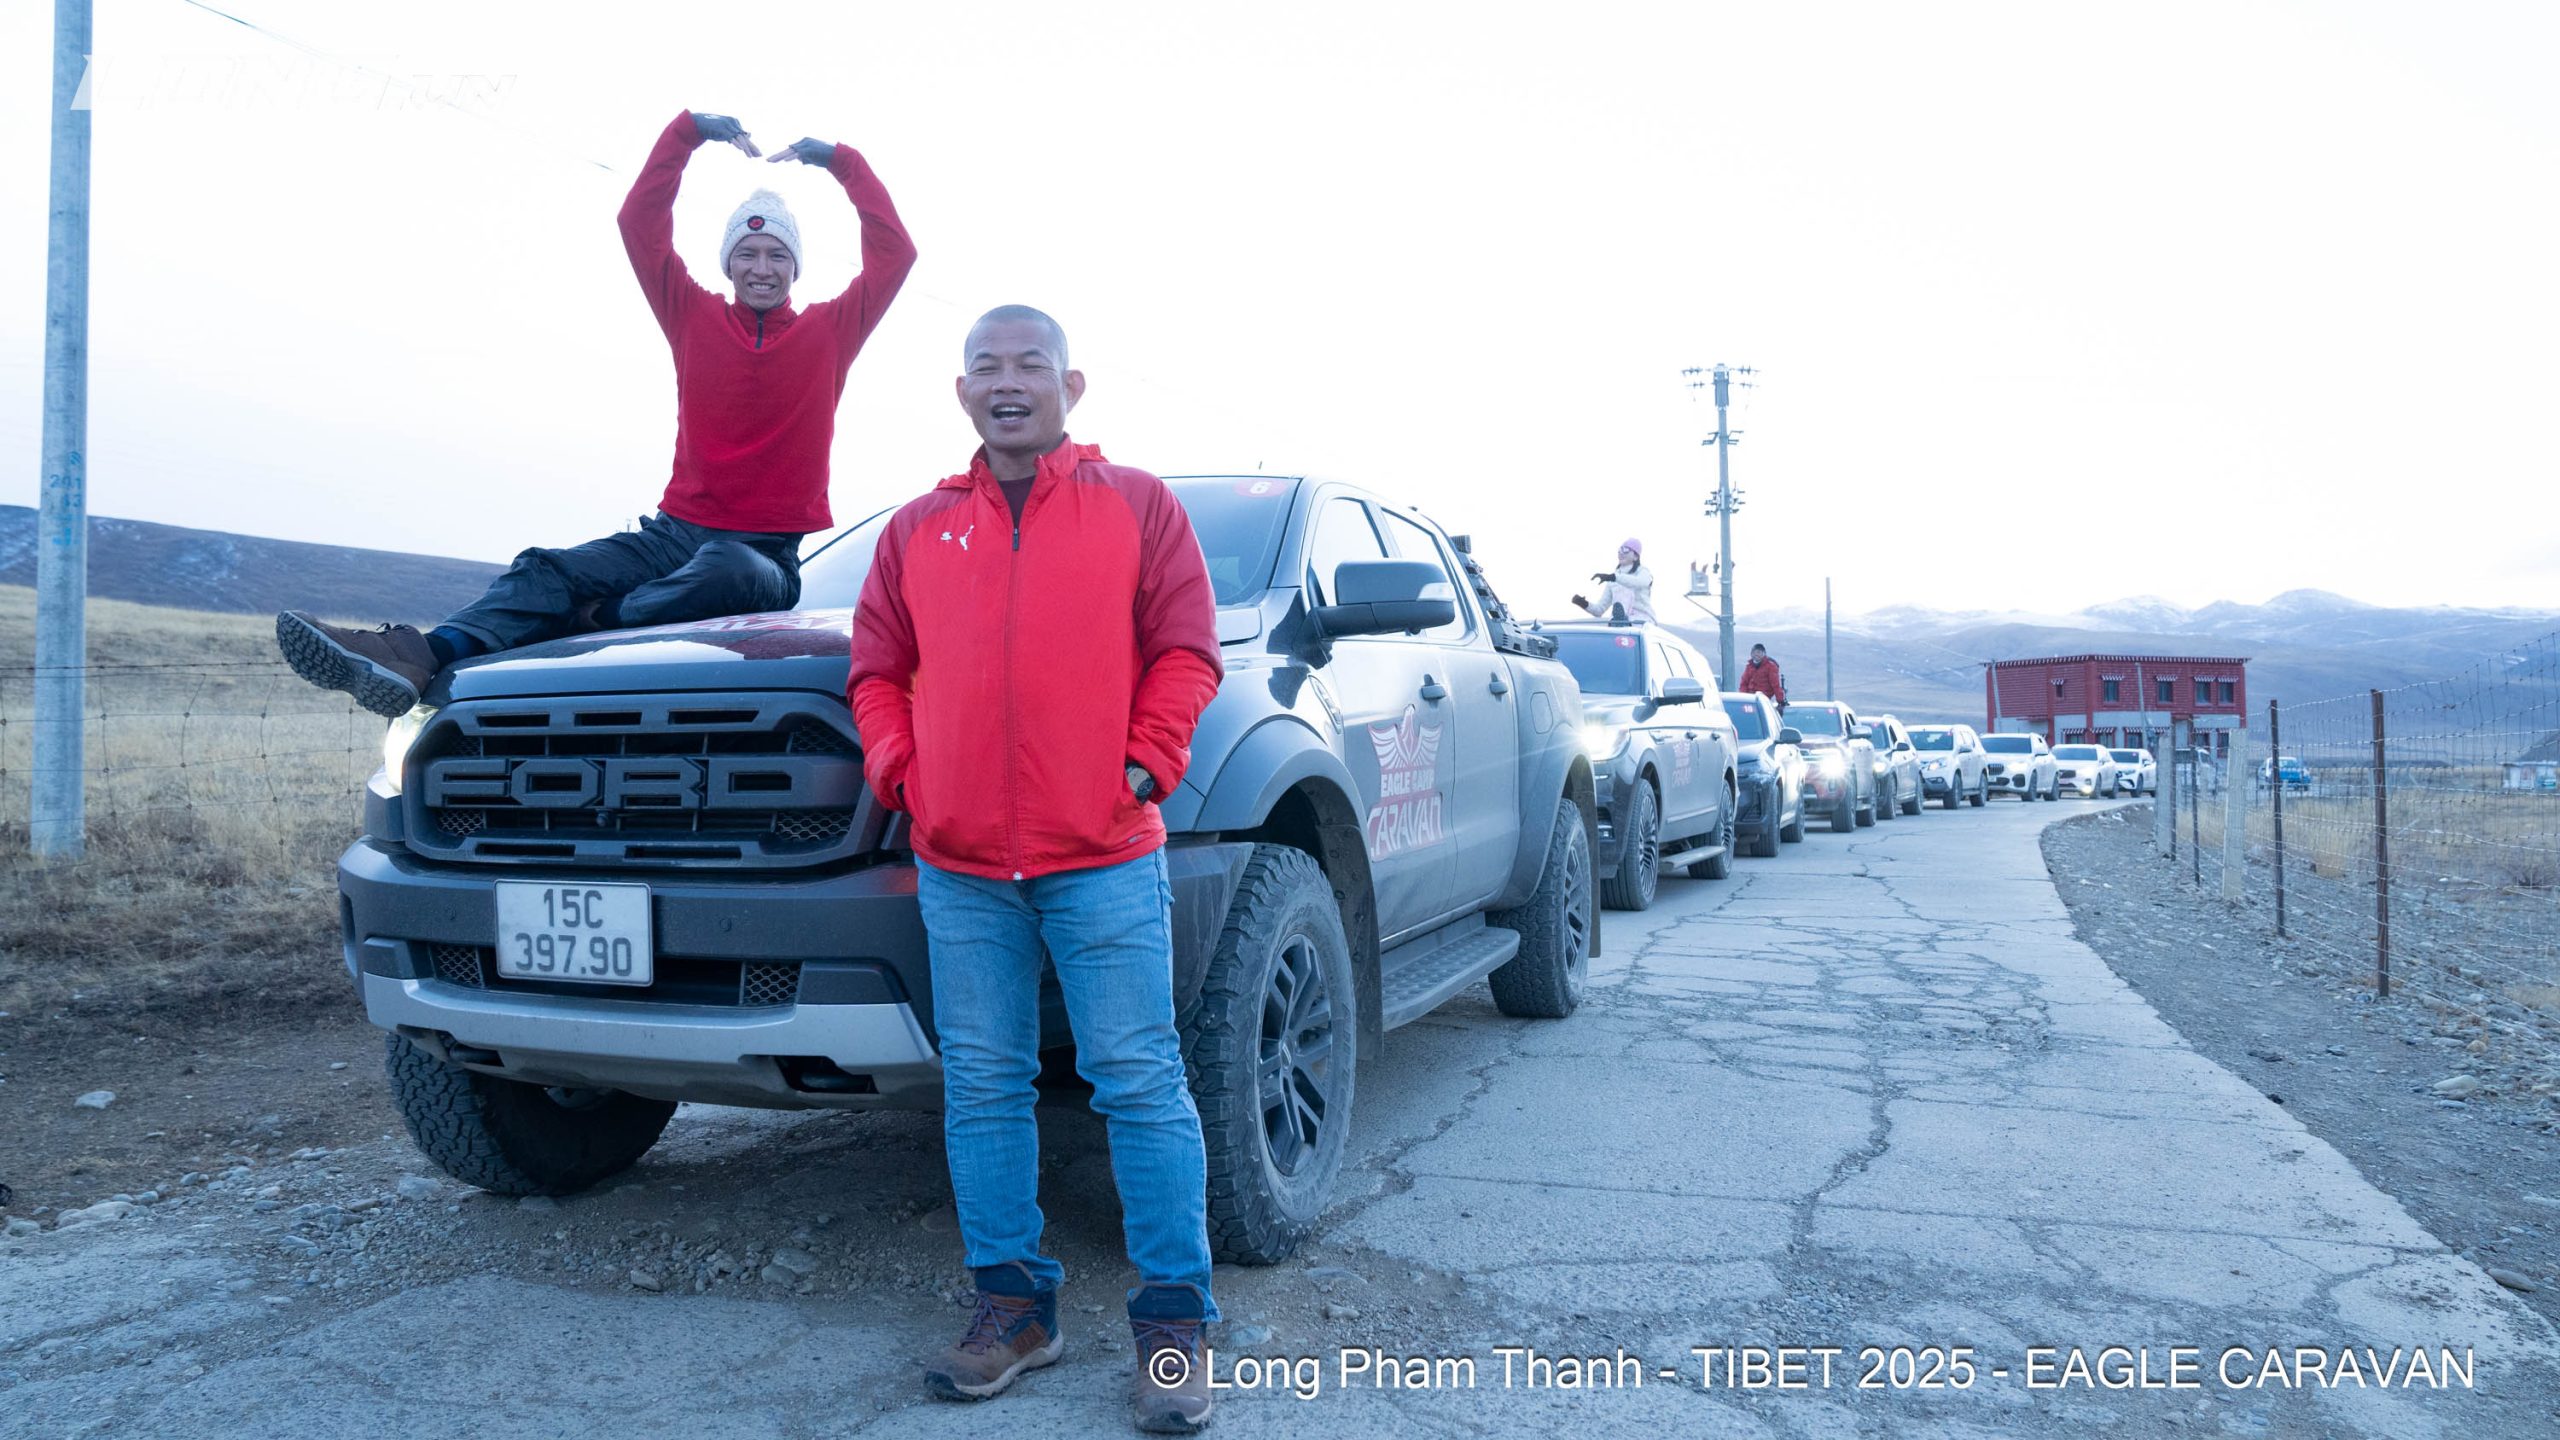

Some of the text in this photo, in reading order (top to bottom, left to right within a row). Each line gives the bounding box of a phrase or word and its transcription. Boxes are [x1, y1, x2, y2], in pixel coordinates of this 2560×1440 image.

[1248, 481, 1273, 495] 6
[424, 757, 805, 809] FORD
[1381, 771, 1411, 798] EAGLE
[1367, 796, 1443, 857] CARAVAN
[543, 888, 604, 929] 15C
[514, 932, 633, 978] 397.90
